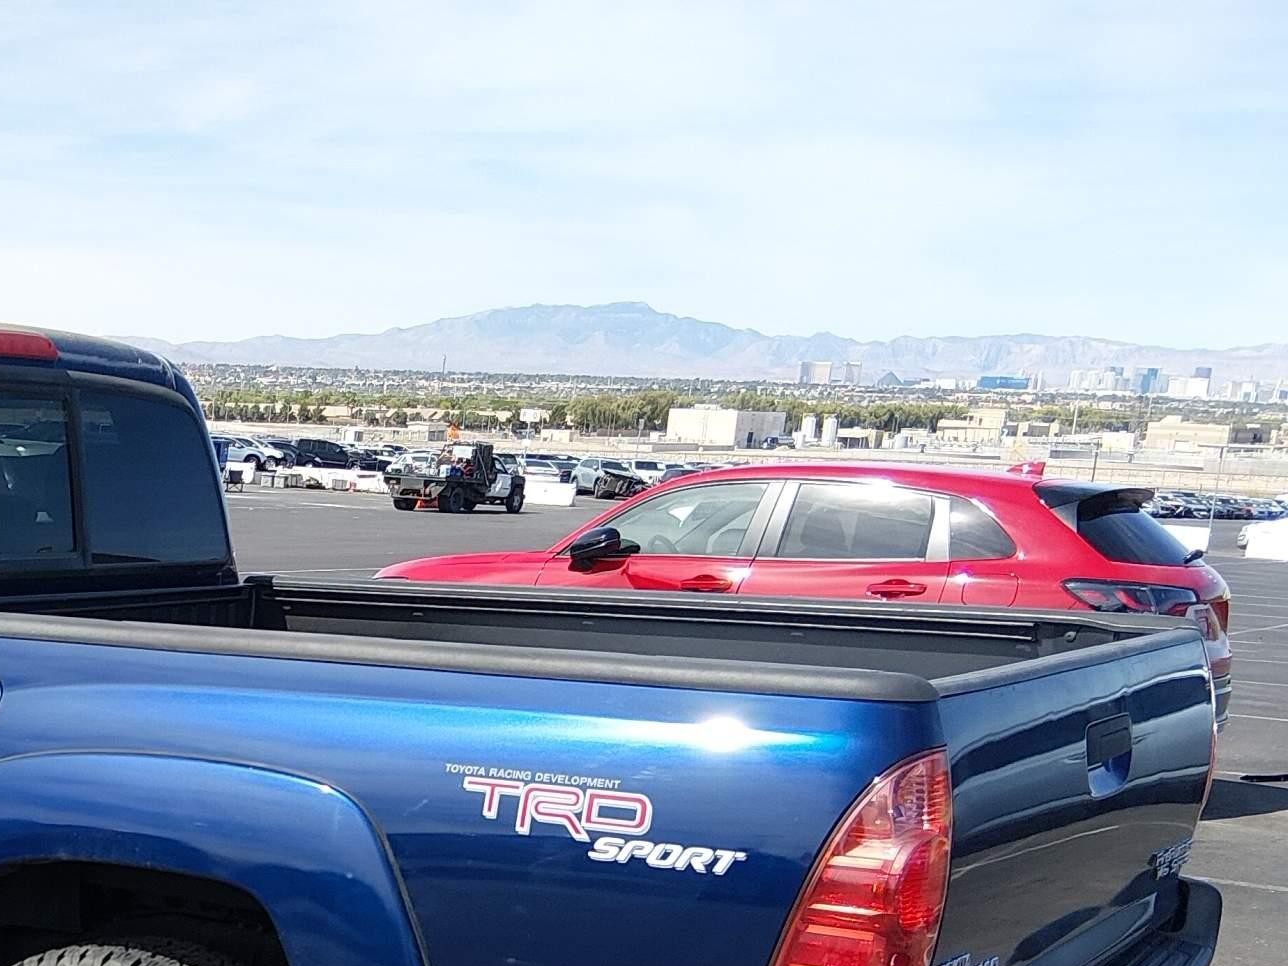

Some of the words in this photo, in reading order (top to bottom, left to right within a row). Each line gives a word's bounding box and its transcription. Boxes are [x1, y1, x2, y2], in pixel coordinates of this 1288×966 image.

[445, 763, 486, 776] TOYOTA
[489, 768, 532, 781] RACING
[535, 772, 621, 789] DEVELOPMENT
[463, 776, 653, 842] TRD
[588, 837, 748, 876] SPORT
